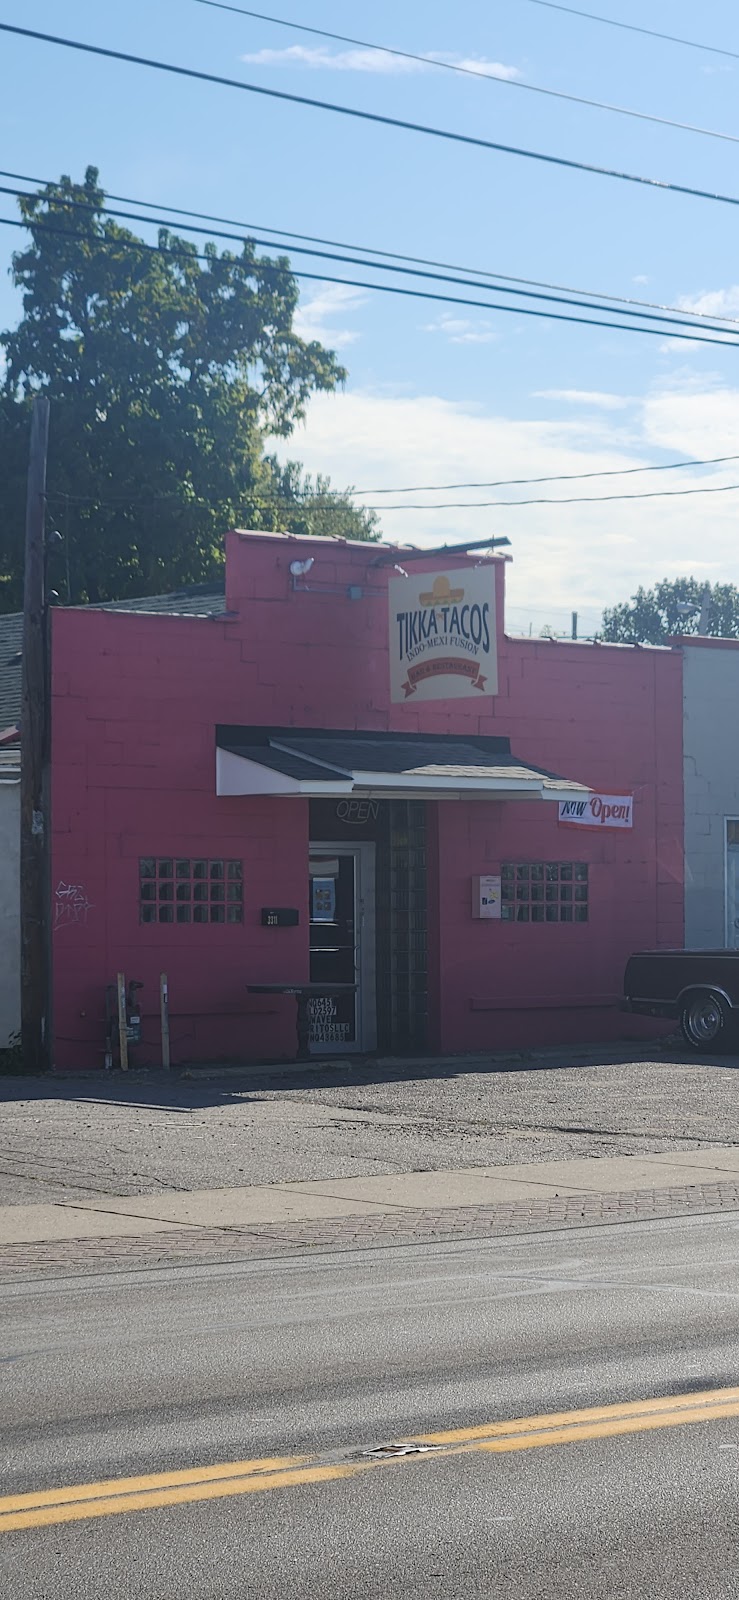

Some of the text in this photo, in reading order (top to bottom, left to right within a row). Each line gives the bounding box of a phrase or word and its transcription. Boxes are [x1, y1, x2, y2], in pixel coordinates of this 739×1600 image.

[397, 602, 489, 661] TIKKA TACOS
[406, 636, 479, 661] INDO-MEXI FUSION
[336, 800, 380, 819] OPEN
[589, 797, 630, 823] Open!
